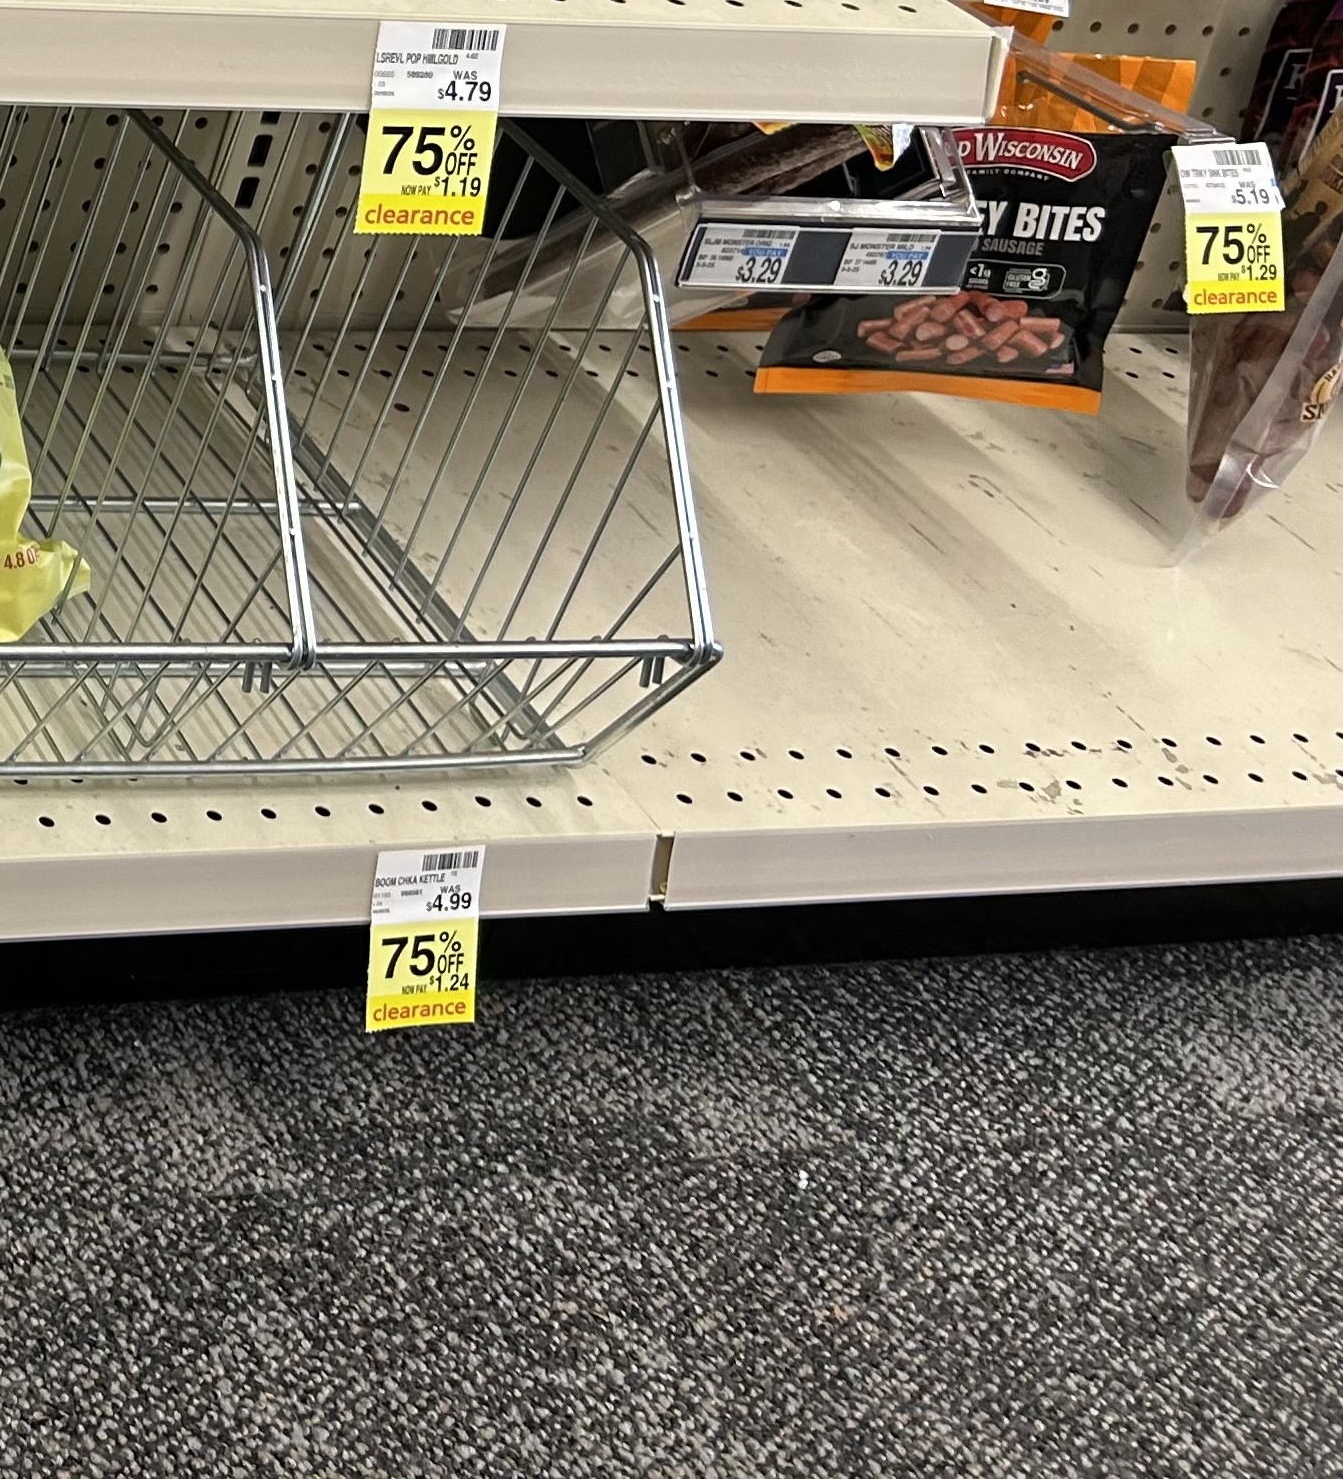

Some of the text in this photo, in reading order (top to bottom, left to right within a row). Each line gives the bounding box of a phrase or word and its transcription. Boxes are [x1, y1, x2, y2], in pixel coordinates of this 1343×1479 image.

[453, 71, 477, 80] WAS
[438, 81, 491, 101] $4.79
[382, 125, 477, 176] 75% OFF
[434, 176, 481, 197] $1.19
[1231, 188, 1270, 205] $5.19
[365, 204, 475, 225] clearance
[1013, 202, 1106, 241] BITES
[982, 238, 1044, 256] SAUSAGE
[736, 257, 782, 284] $3.29
[879, 260, 923, 287] $3.29
[1241, 264, 1278, 282] $1.29
[375, 874, 445, 888] BOOM CHKA KETTLE
[426, 892, 472, 912] $4.99
[429, 973, 469, 993] $1.24
